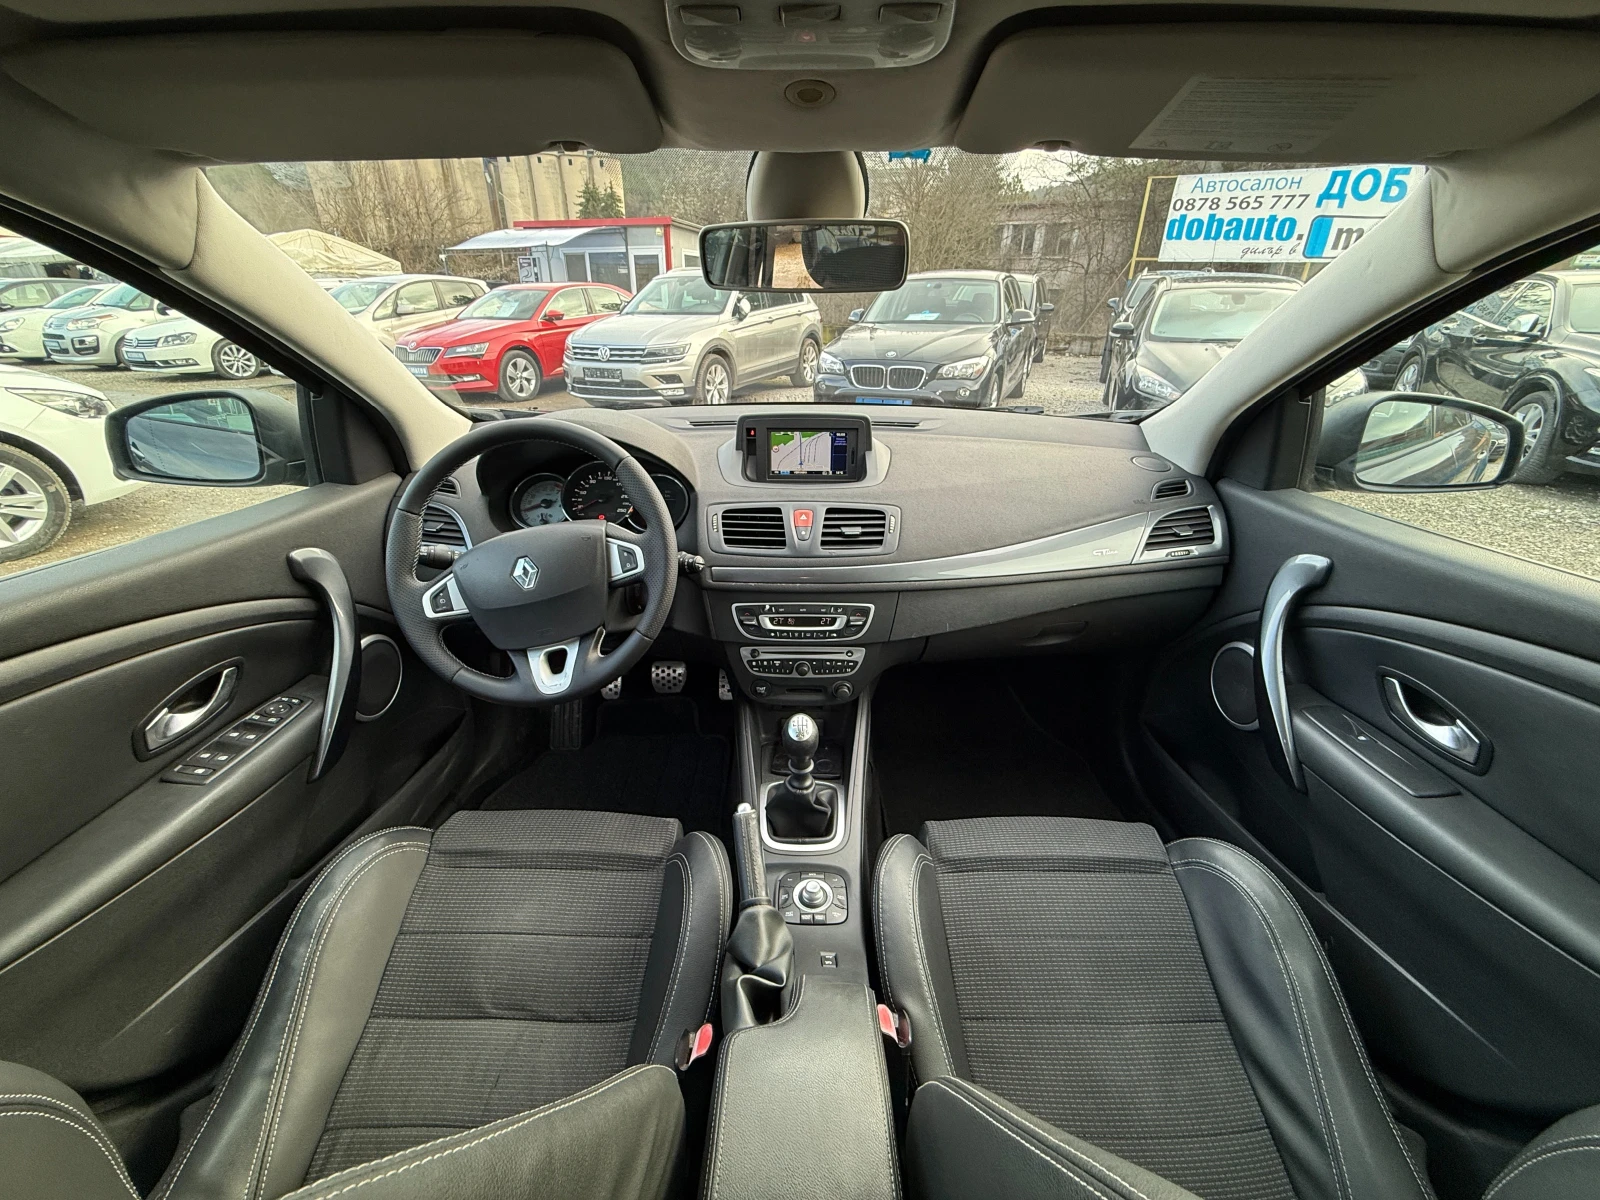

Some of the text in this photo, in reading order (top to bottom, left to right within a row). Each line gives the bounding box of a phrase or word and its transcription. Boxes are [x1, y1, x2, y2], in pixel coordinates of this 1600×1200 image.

[1190, 176, 1303, 194] Автосалон
[1315, 167, 1412, 209] ДОБ
[1172, 193, 1311, 212] 0878 565 777
